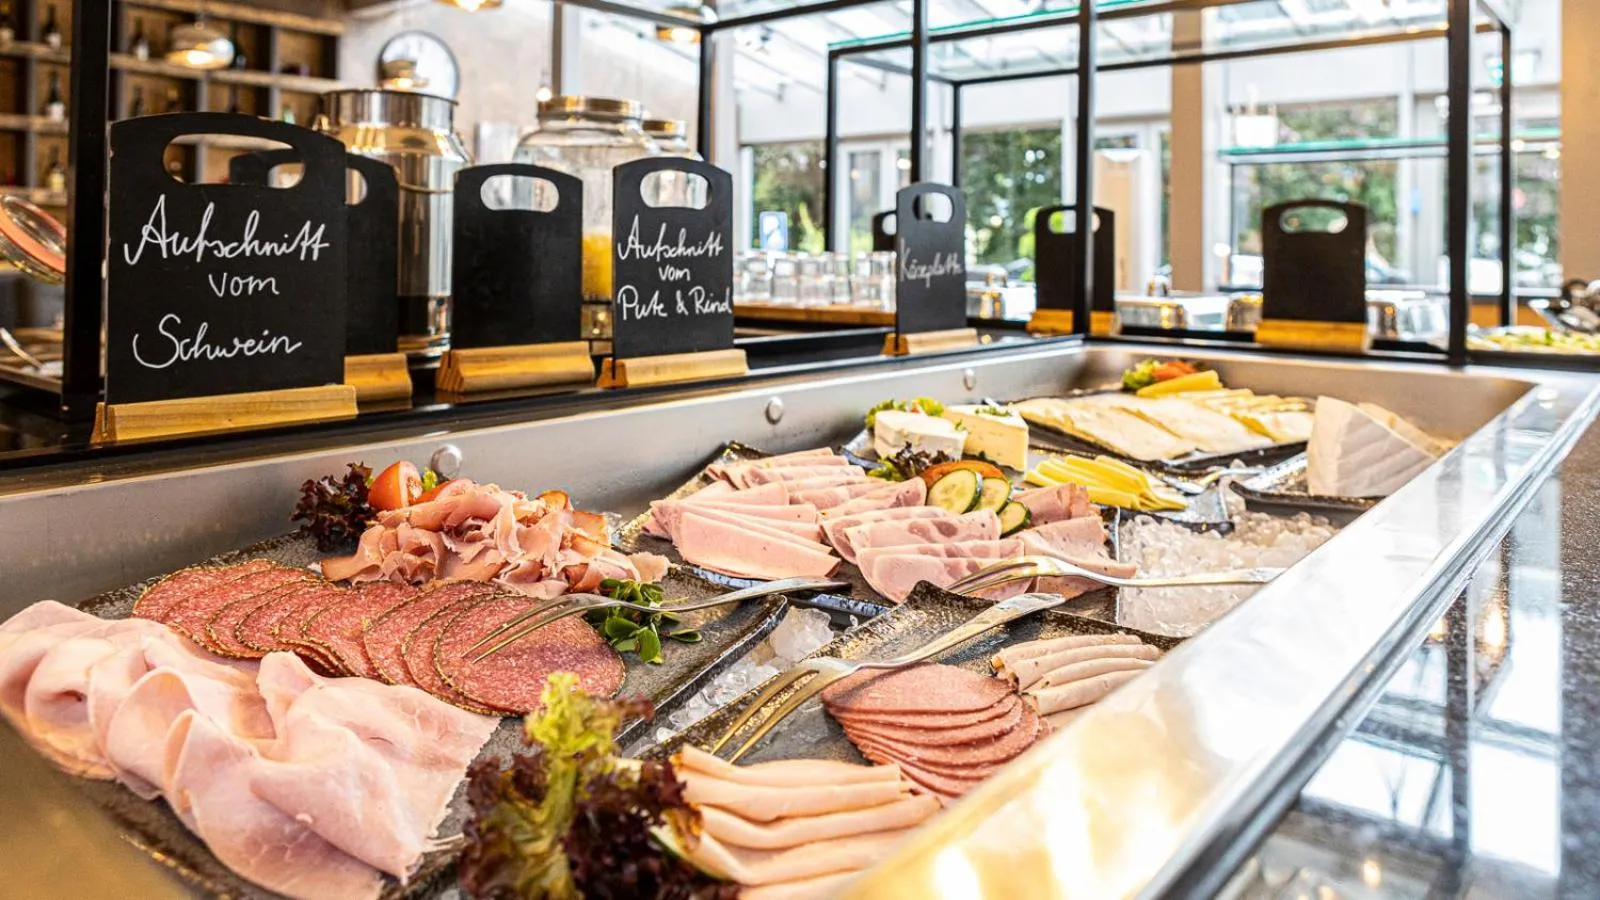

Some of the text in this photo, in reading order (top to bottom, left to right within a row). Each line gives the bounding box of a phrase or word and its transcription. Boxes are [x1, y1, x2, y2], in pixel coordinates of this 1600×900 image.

[123, 193, 331, 266] Aufschnitt
[617, 213, 724, 262] Aufschnitt
[208, 271, 281, 298] vom
[658, 264, 691, 281] vom
[617, 284, 733, 321] Pute & Rind
[132, 313, 303, 369] Schwein
